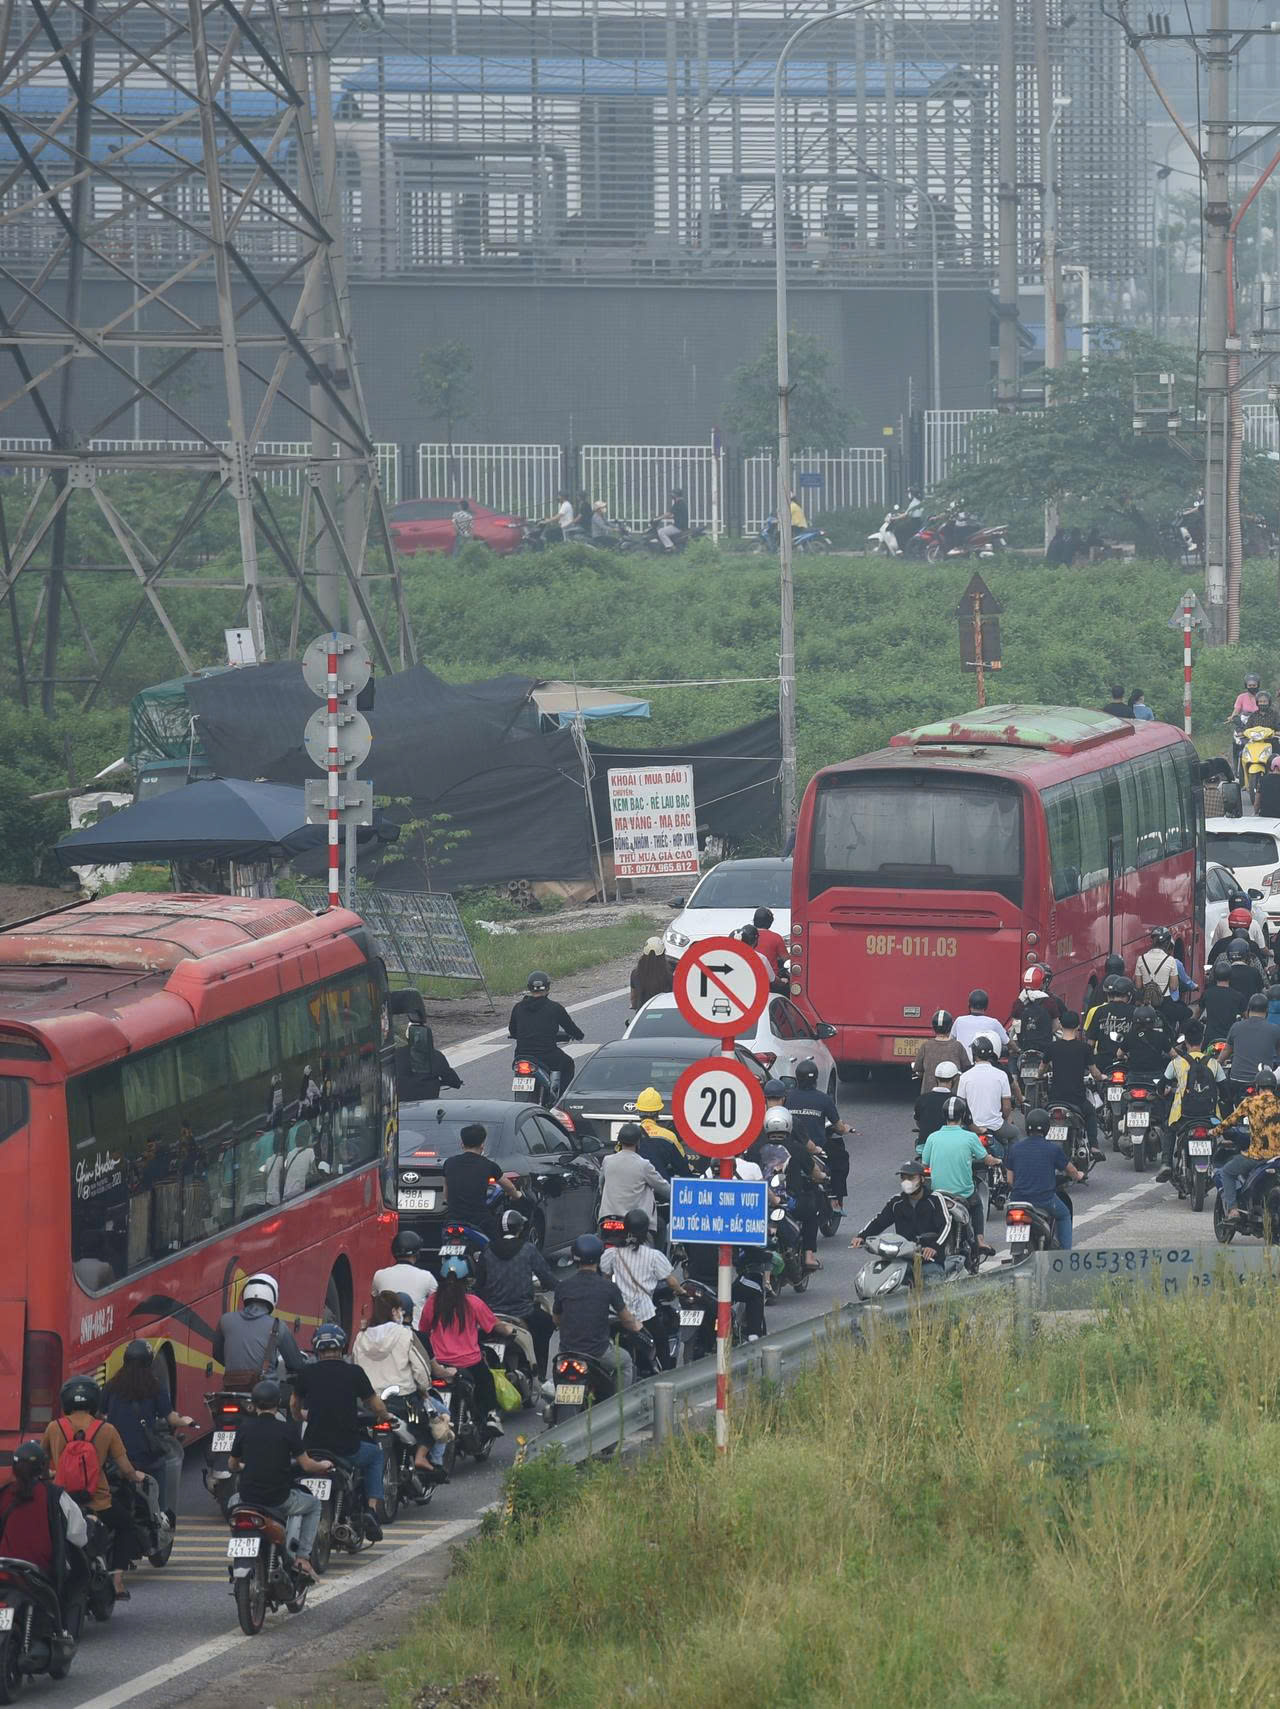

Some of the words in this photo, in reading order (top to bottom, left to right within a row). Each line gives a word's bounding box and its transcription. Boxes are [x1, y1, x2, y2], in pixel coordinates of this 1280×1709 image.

[613, 797, 629, 812] KEM
[866, 935, 957, 957] 98F-011.03
[700, 1086, 737, 1128] 20
[405, 1190, 423, 1198] 98A
[698, 1189, 713, 1205] DÂN
[719, 1191, 735, 1206] SINH
[672, 1216, 685, 1231] CAO
[687, 1212, 700, 1231] TỐC
[701, 1215, 711, 1232] HÀ
[712, 1215, 724, 1234] NỘI
[730, 1212, 743, 1232] BẮC
[745, 1219, 765, 1233] GIANG
